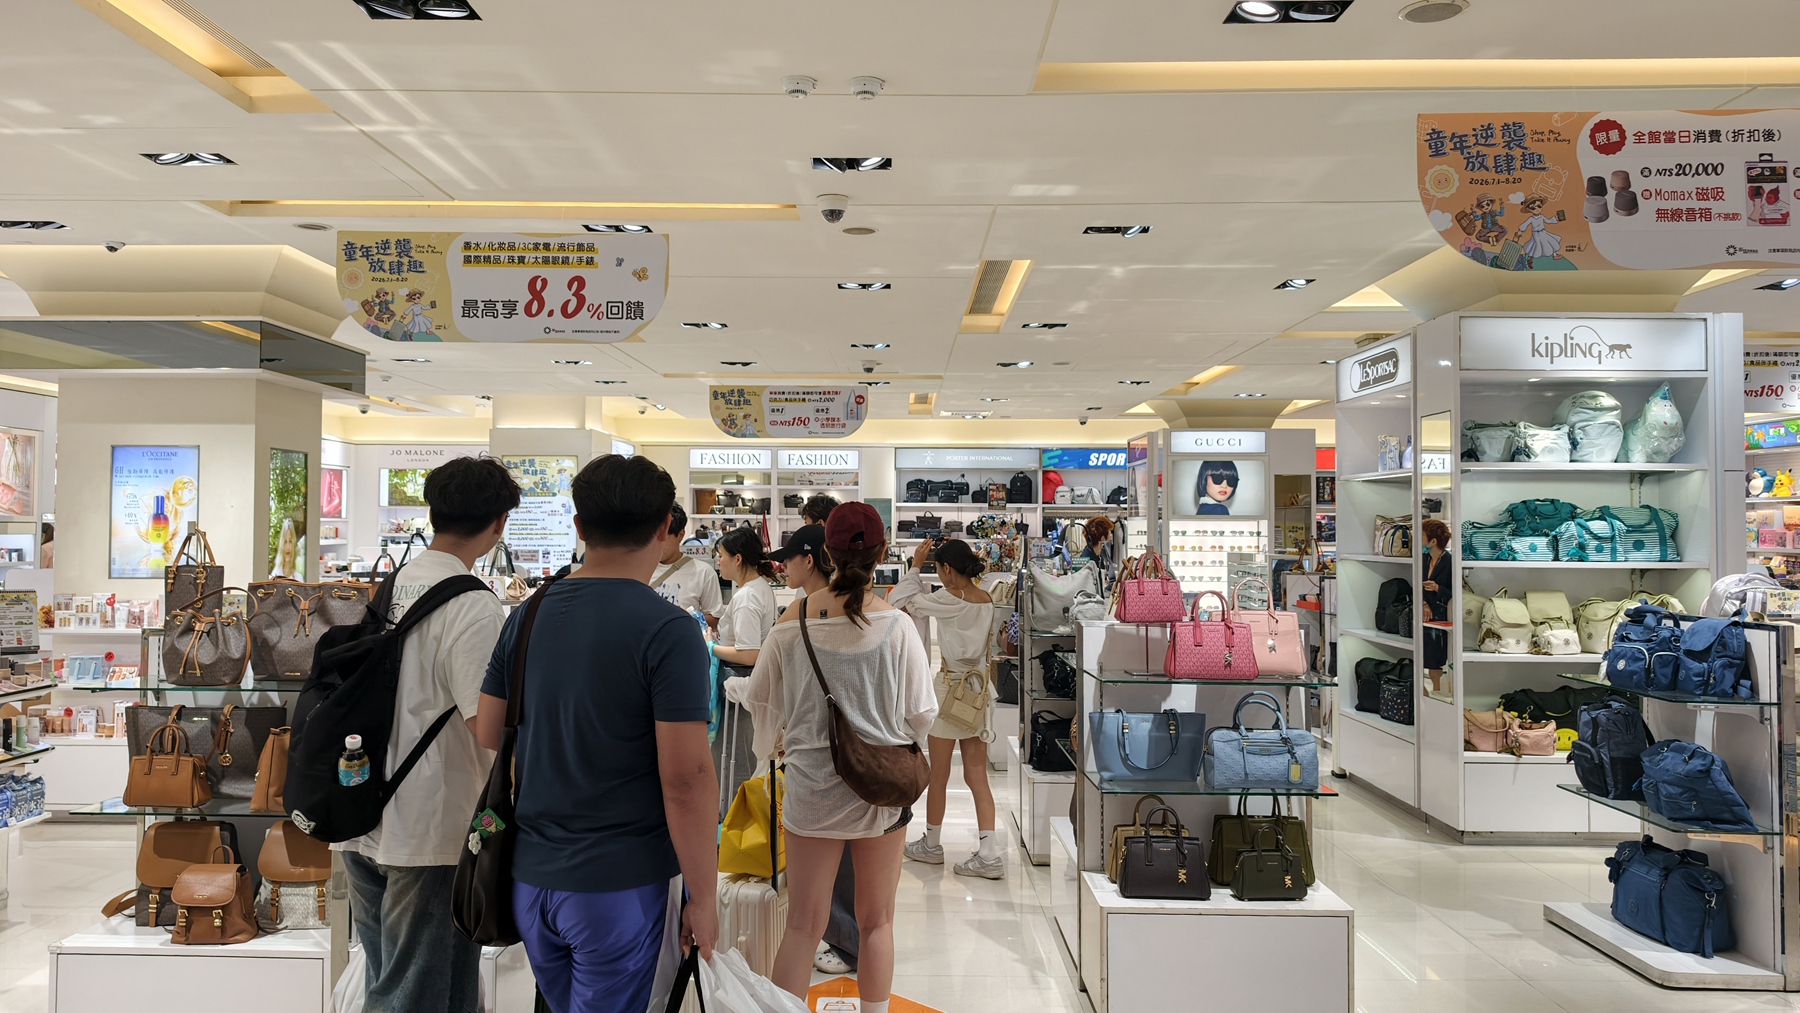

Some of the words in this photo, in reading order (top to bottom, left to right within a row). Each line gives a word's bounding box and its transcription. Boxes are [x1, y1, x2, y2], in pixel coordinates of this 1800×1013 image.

[1424, 121, 1531, 157] 童年逆襲
[1595, 129, 1621, 146] 限量
[1464, 150, 1549, 176] 放肆趣
[342, 239, 414, 262] 童年逆襲
[368, 258, 426, 276] 放肆趣
[1531, 333, 1602, 364] kipling
[1195, 438, 1242, 446] GUCCI
[700, 453, 762, 464] FASHION
[788, 454, 849, 465] FASHION
[1088, 452, 1127, 466] SPOR
